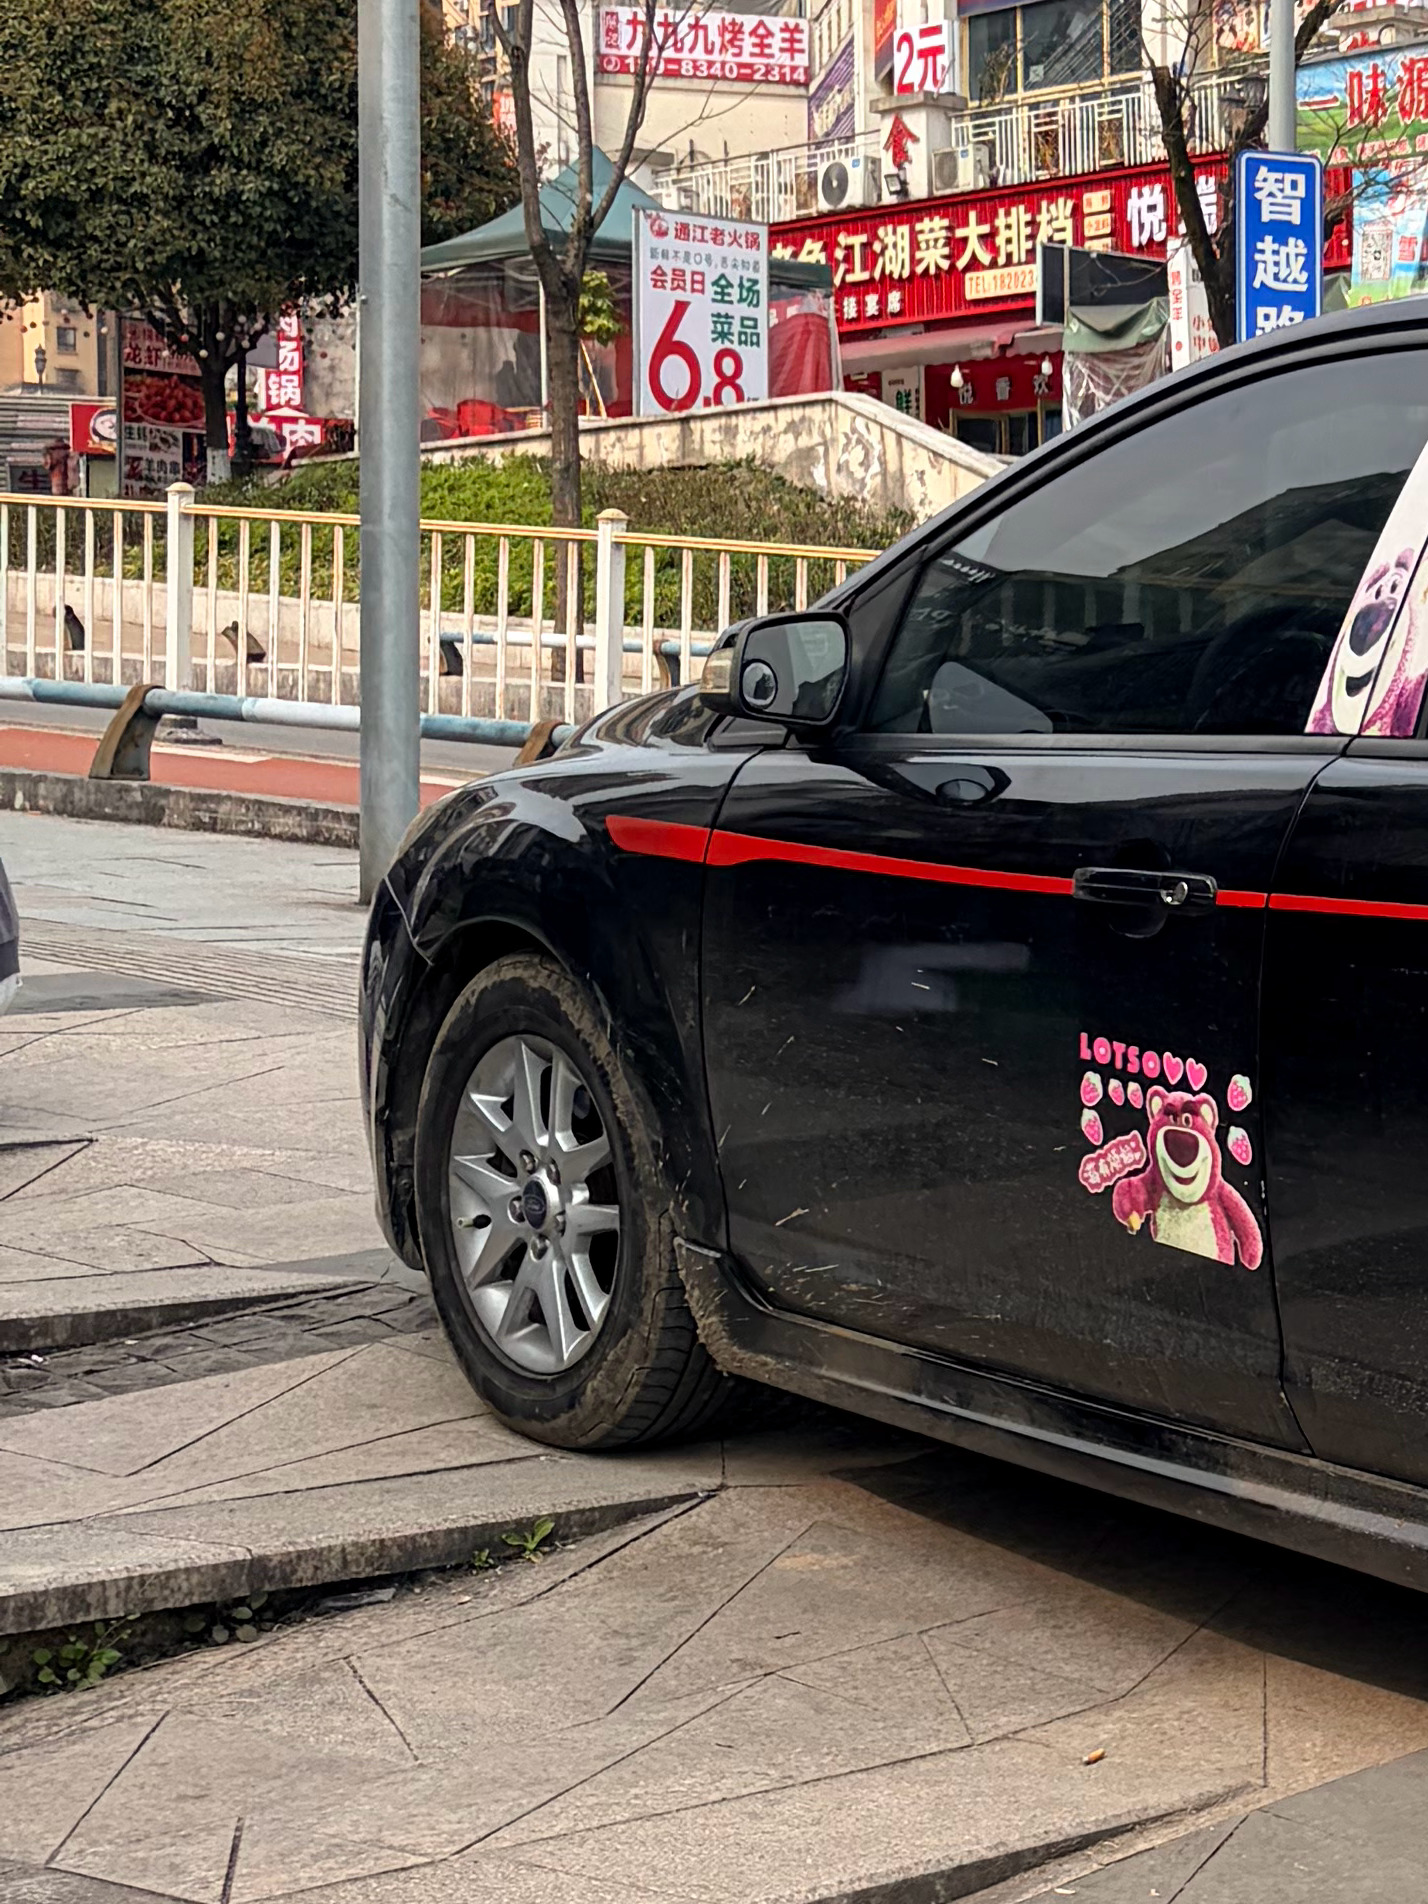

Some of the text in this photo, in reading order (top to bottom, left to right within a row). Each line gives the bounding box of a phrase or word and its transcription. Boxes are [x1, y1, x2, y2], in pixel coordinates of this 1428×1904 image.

[626, 11, 805, 62] 九九九烤全羊
[896, 24, 946, 94] 2元
[674, 221, 761, 251] 通江老火锅
[650, 265, 706, 295] 会员日
[711, 273, 760, 308] 全场
[711, 312, 760, 348] 菜品
[1080, 1032, 1161, 1078] LOTSO
